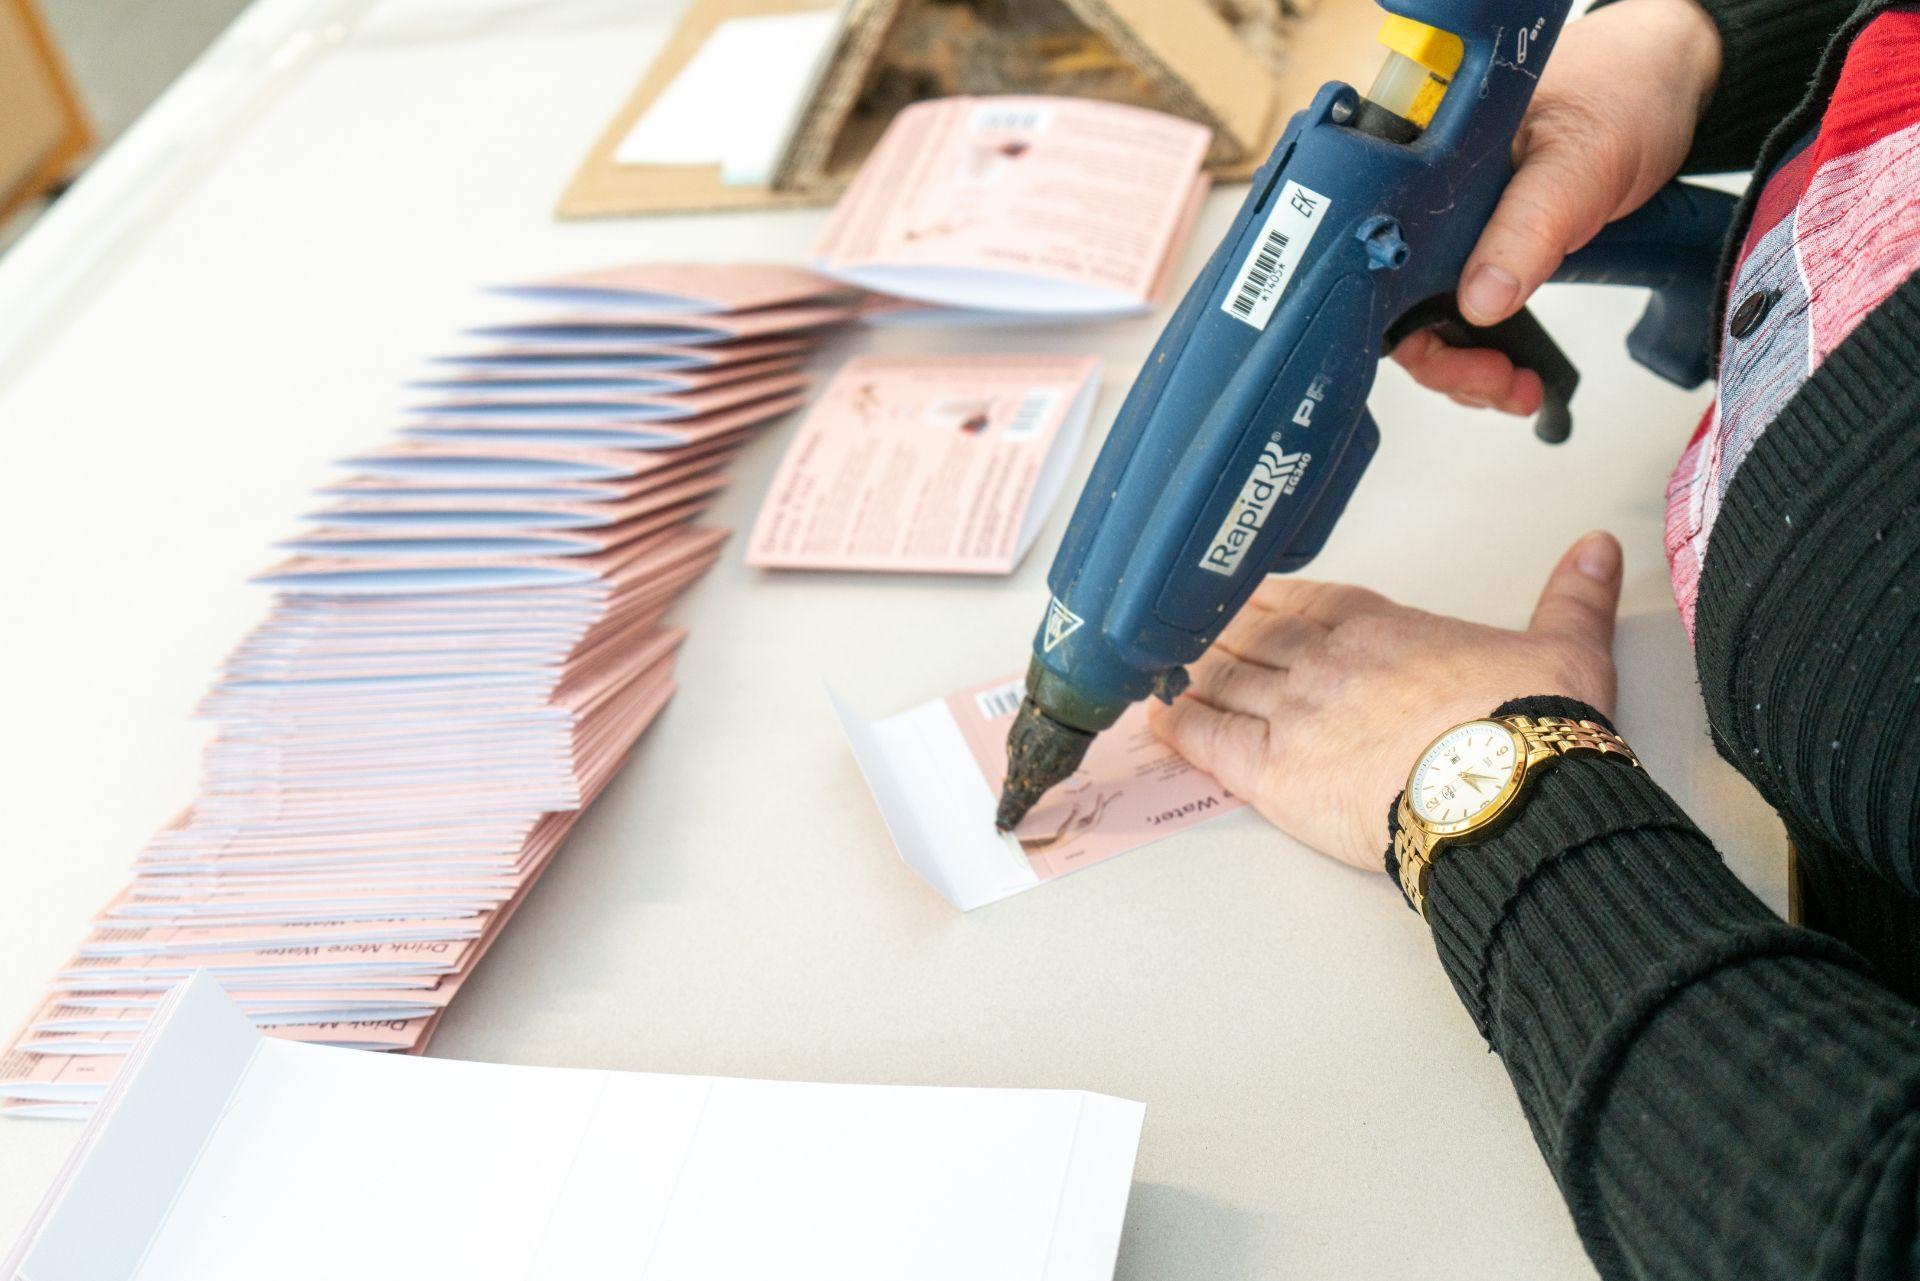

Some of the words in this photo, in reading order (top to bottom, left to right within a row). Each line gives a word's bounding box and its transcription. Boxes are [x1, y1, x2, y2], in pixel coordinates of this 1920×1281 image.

[1290, 188, 1318, 218] EK
[1208, 479, 1274, 567] Rapid
[328, 943, 382, 953] More
[390, 943, 449, 954] Drink
